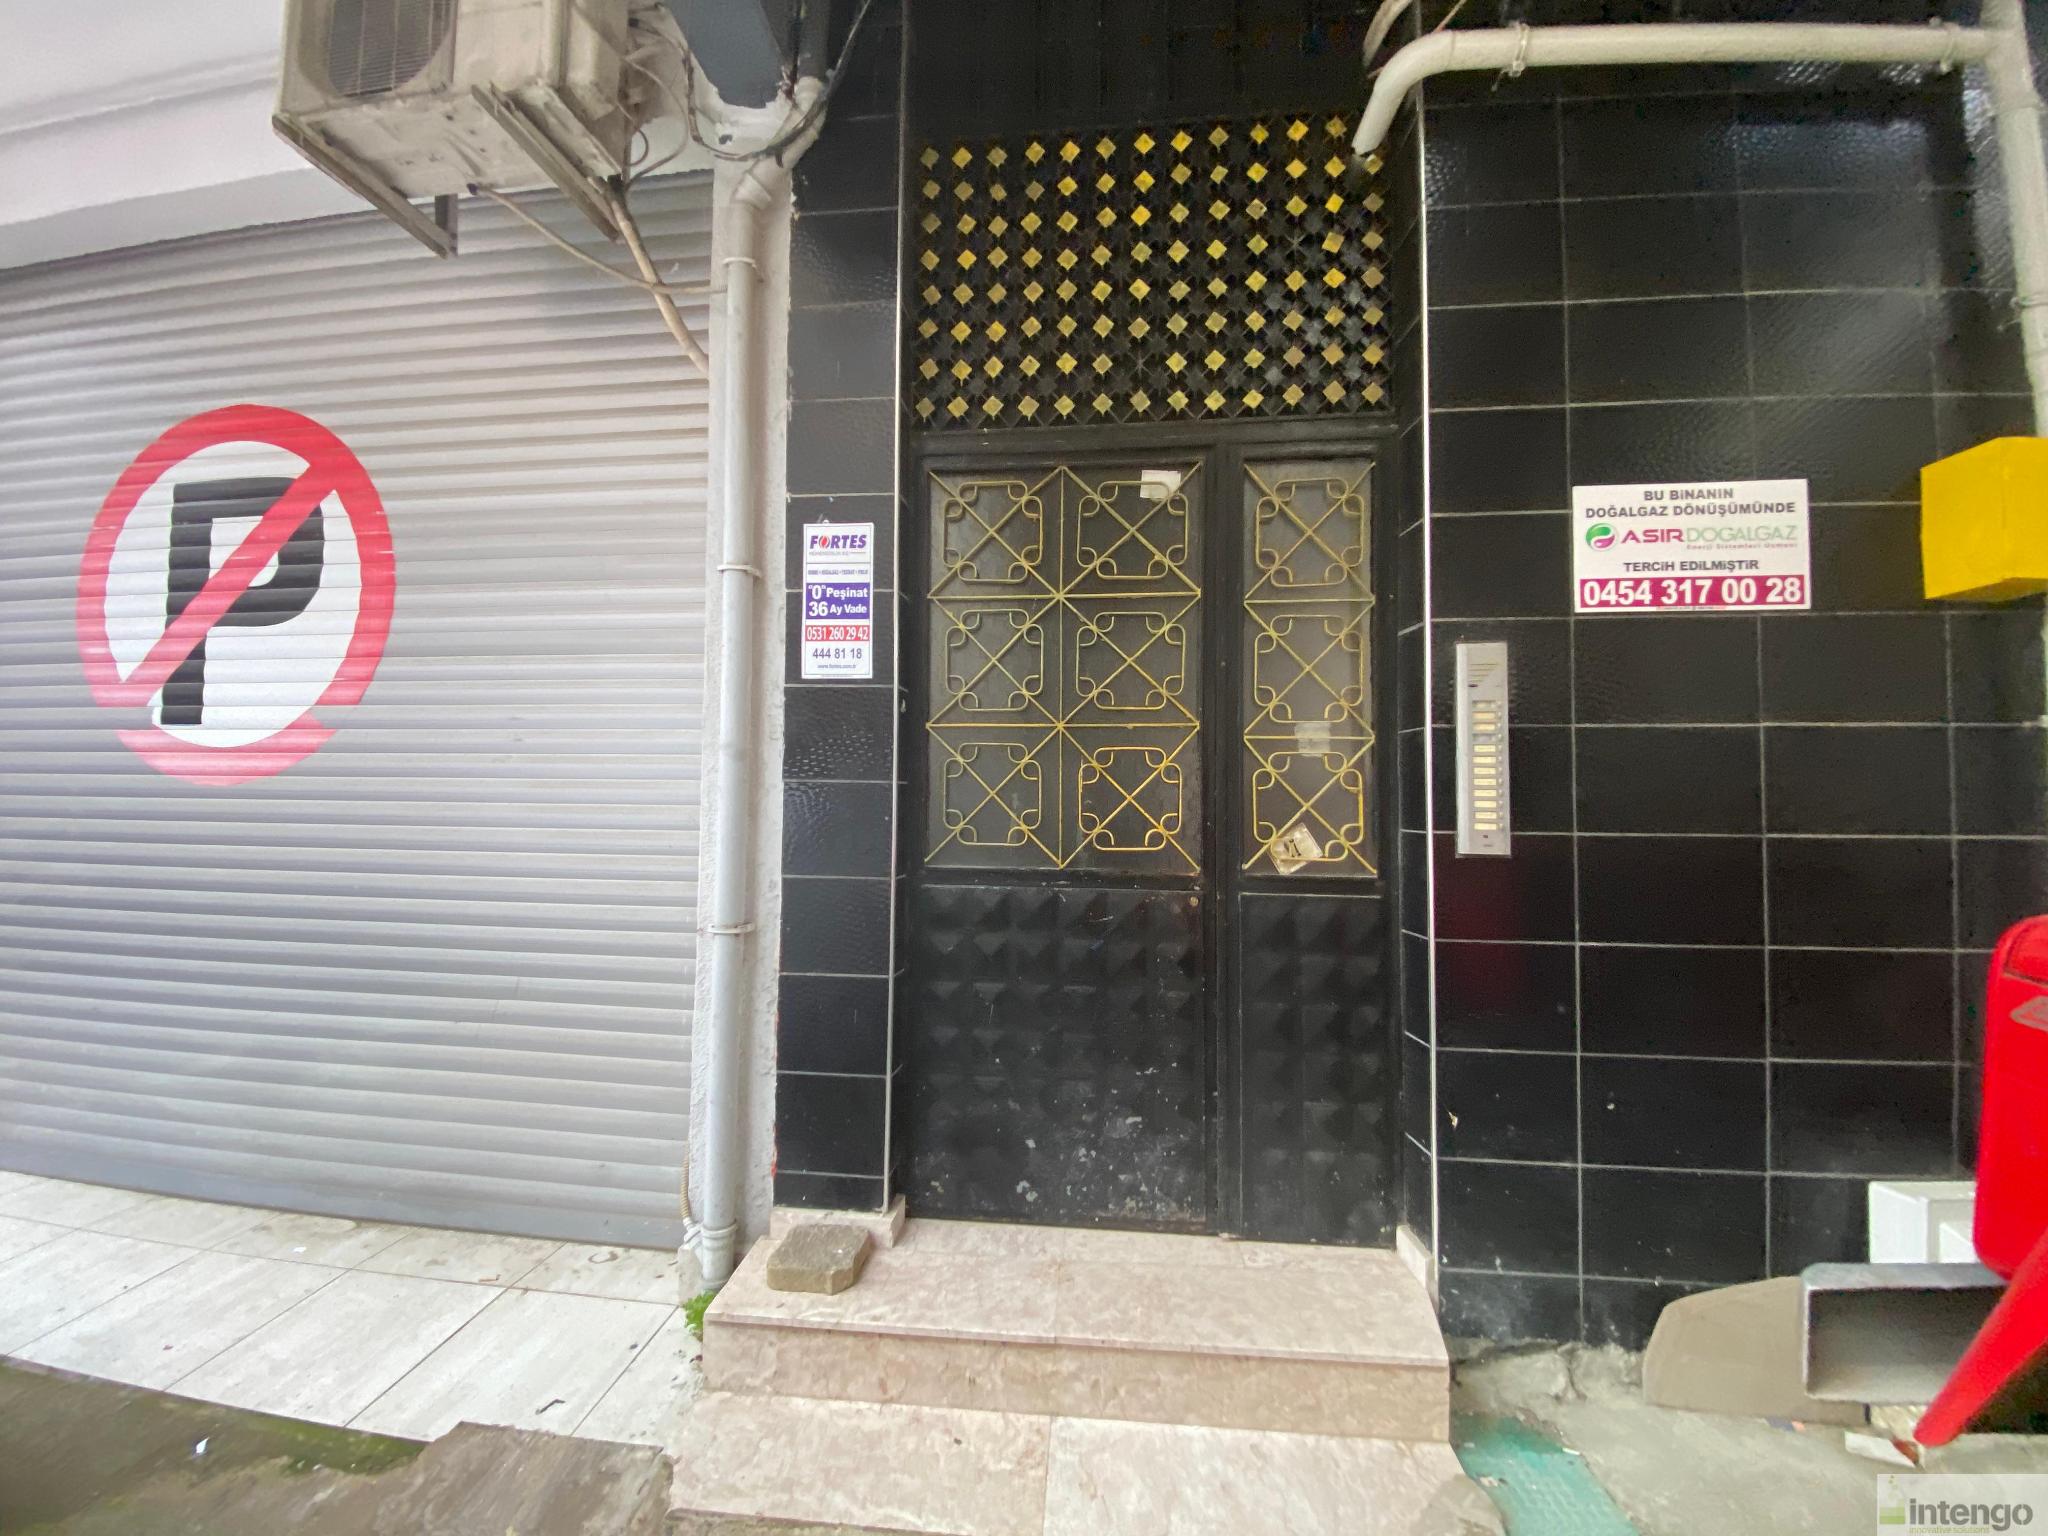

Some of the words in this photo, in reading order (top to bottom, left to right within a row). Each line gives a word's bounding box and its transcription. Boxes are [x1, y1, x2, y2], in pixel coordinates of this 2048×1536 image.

[1643, 490, 1664, 501] BU
[1585, 504, 1669, 519] DOĞALGAZ
[1673, 501, 1796, 517] DÖNÜŞÜMÜNDE
[809, 534, 867, 549] FORTES
[1620, 528, 1685, 544] ASIR
[826, 586, 868, 600] Peşinat
[1583, 579, 1653, 606] 0454
[1661, 578, 1713, 605] 317
[1721, 578, 1757, 604] 00
[1765, 576, 1801, 603] 28
[808, 601, 829, 617] 36
[830, 603, 843, 616] Ay
[843, 603, 868, 614] Vade
[806, 626, 827, 641] 0531
[829, 626, 845, 641] 260
[845, 626, 856, 640] 29
[857, 626, 869, 640] 42
[812, 647, 831, 659] 444
[834, 647, 846, 659] 81
[850, 647, 862, 659] 18
